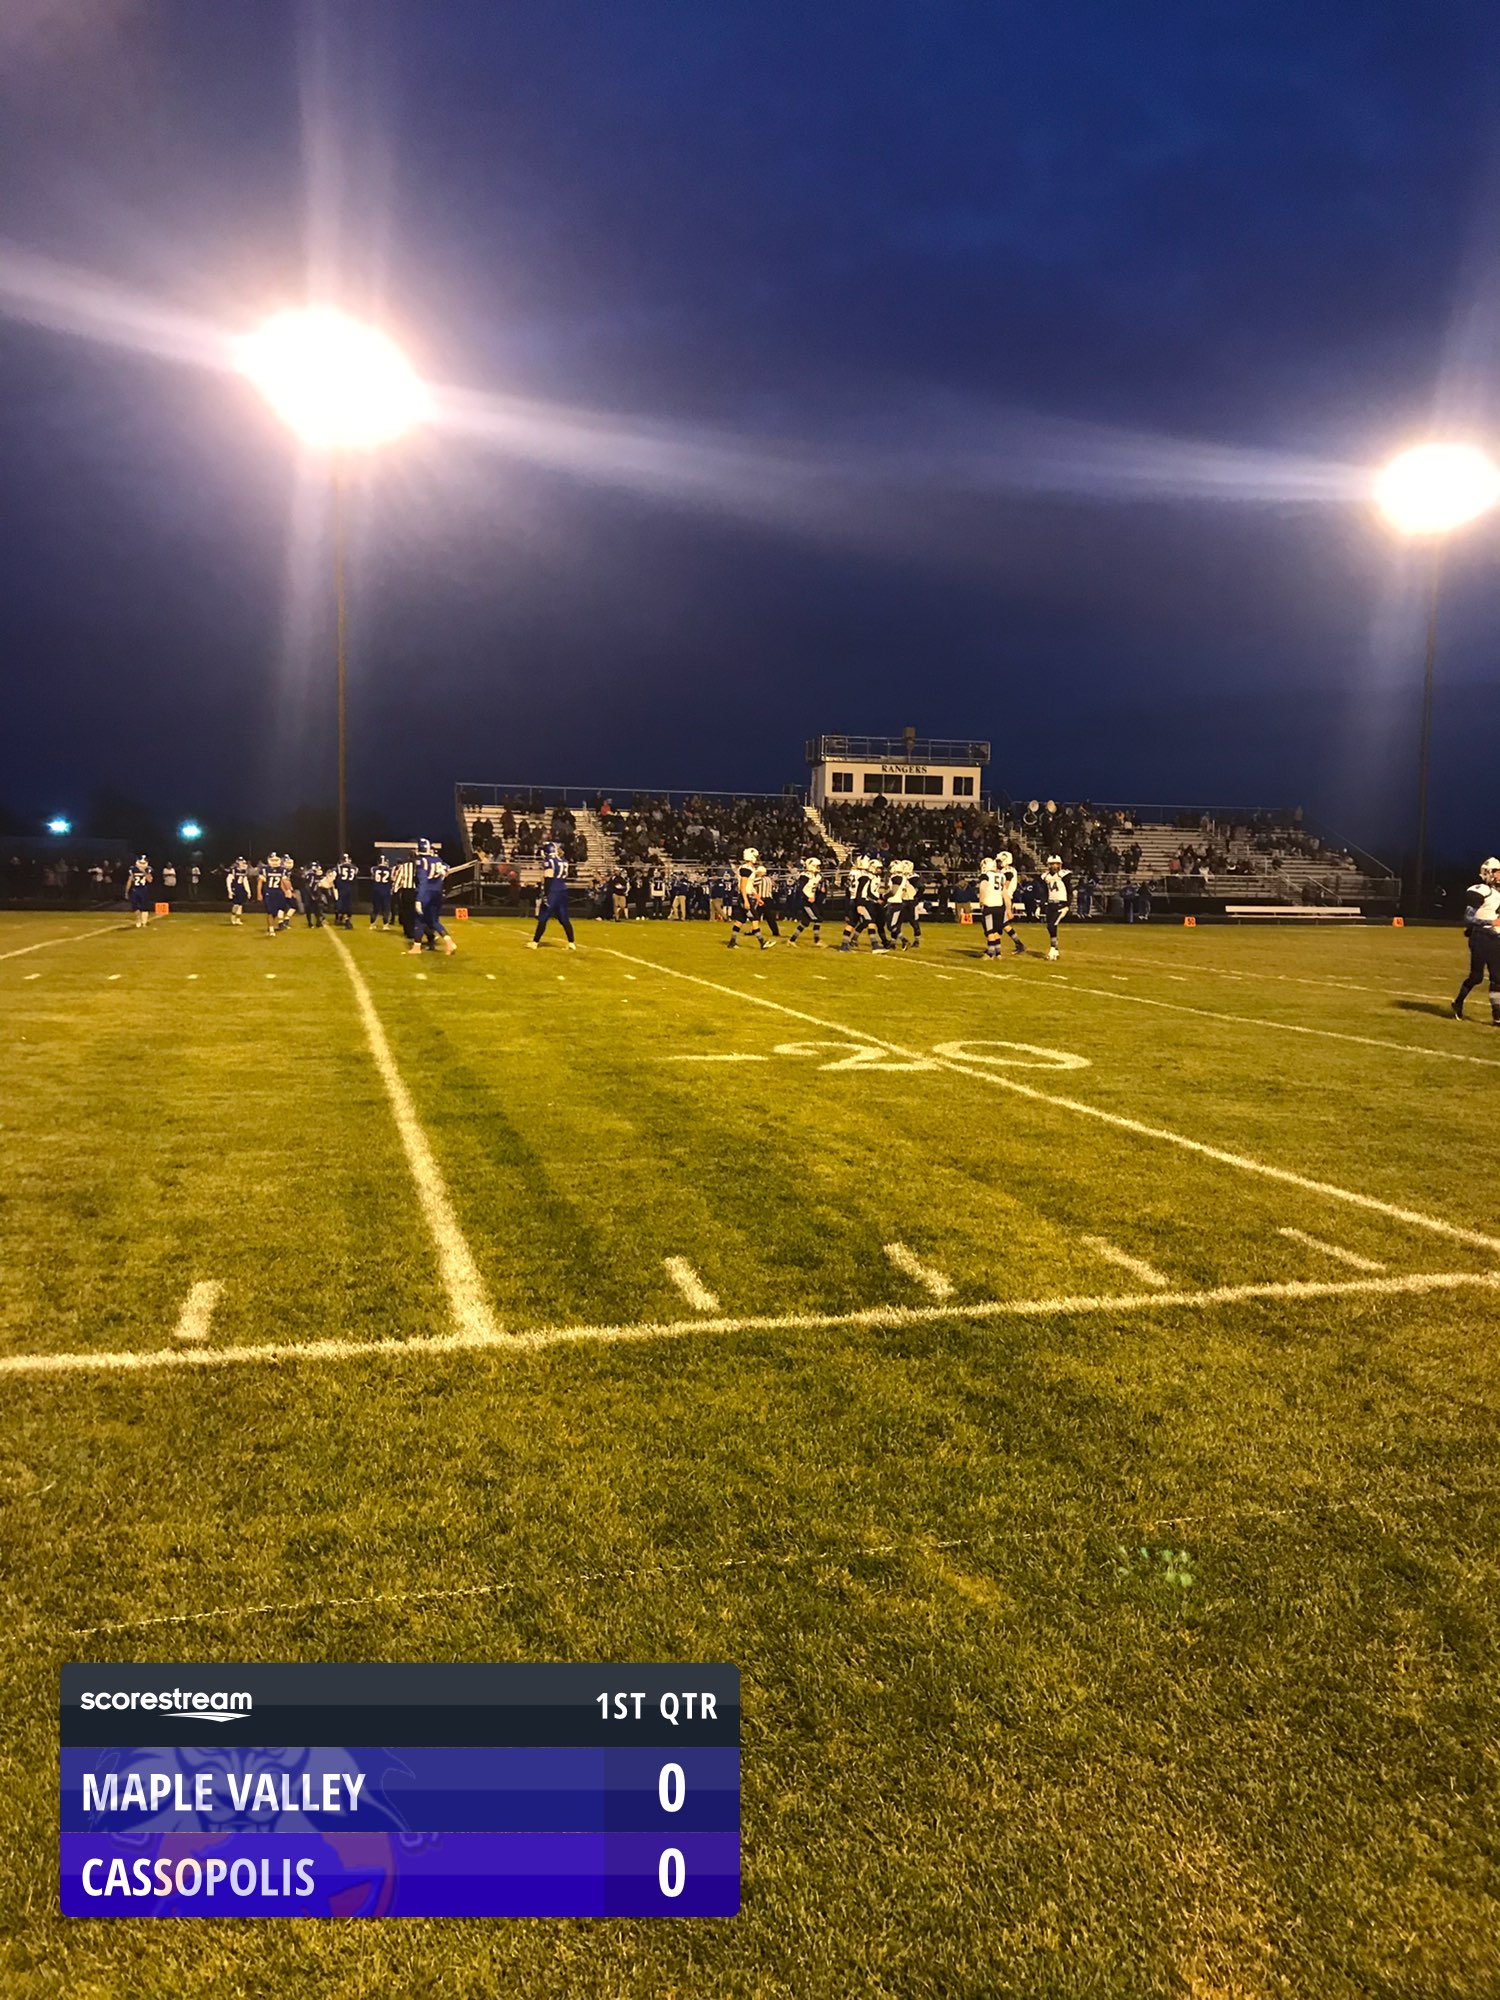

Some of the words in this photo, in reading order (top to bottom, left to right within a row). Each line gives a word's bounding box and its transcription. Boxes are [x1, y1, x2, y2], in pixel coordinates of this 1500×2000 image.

[881, 765, 928, 774] RANGERS
[341, 867, 355, 881] 53
[375, 869, 389, 883] 62
[134, 876, 146, 886] 24
[268, 876, 280, 888] 12
[773, 1041, 1093, 1071] 20
